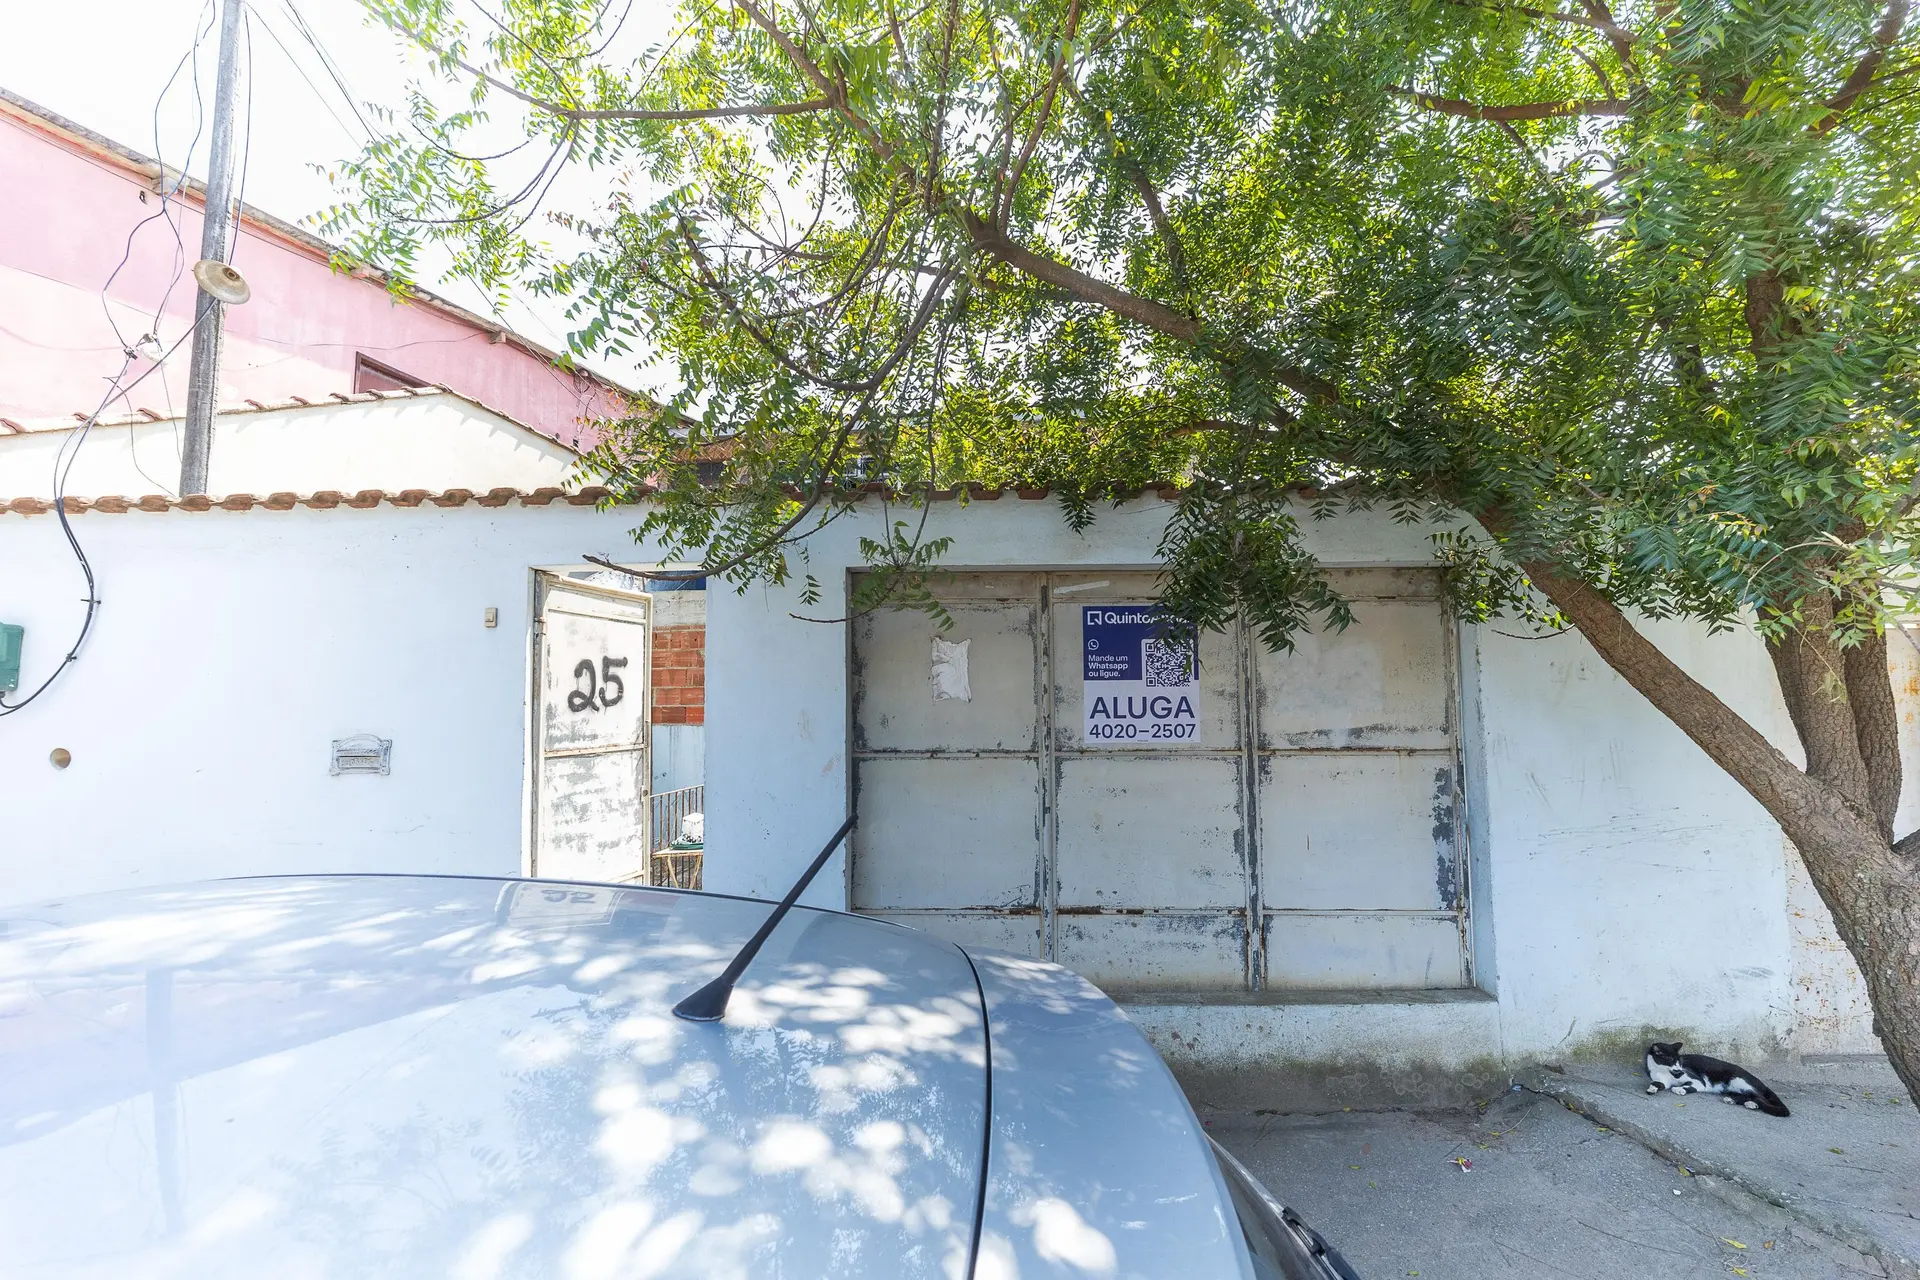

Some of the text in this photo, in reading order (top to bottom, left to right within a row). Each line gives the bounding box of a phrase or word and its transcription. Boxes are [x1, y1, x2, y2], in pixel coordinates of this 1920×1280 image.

[1104, 611, 1190, 624] Quinto
[1088, 662, 1128, 670] Whatsapp
[1099, 670, 1121, 679] ligue.
[567, 655, 628, 713] 25
[1089, 696, 1195, 719] ALUGA
[1089, 723, 1196, 739] 4020-2507
